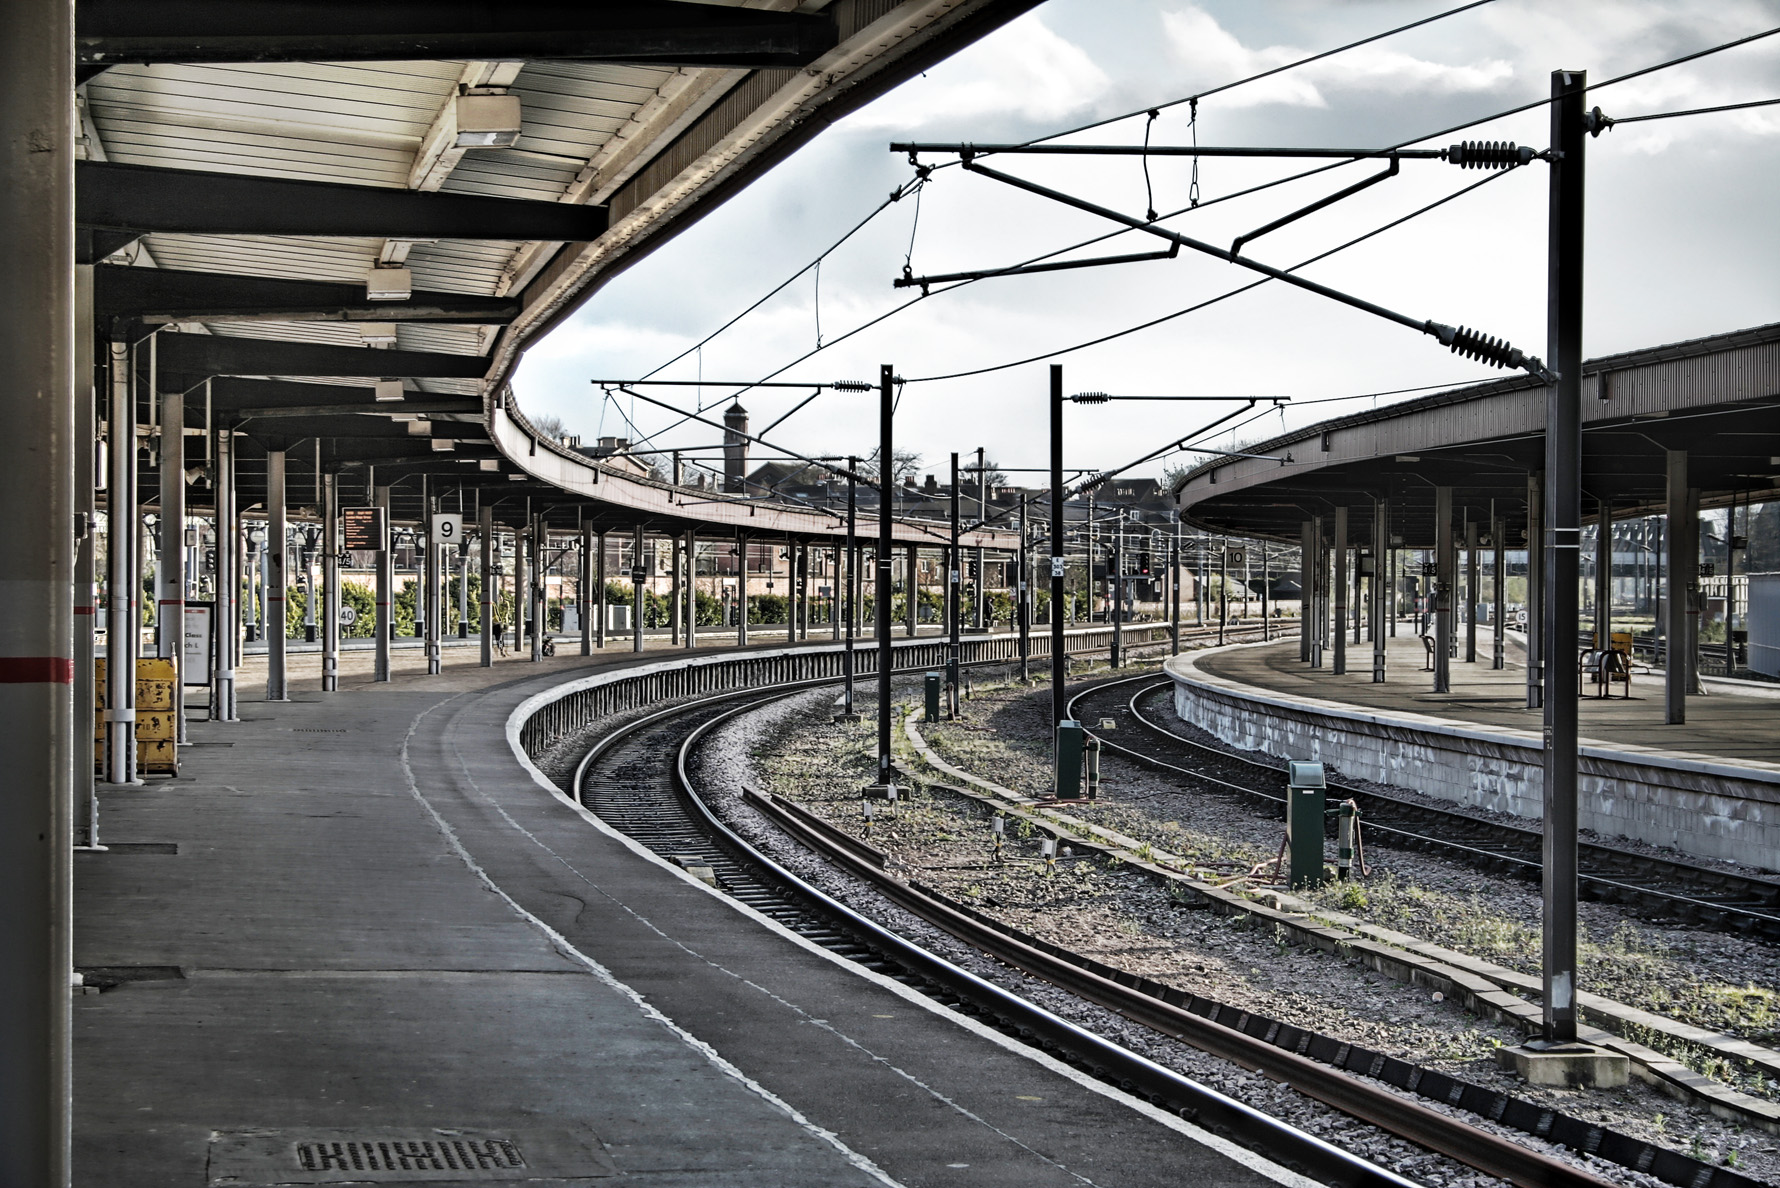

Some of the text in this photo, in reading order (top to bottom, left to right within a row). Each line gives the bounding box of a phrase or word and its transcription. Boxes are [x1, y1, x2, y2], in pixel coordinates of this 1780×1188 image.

[441, 521, 453, 537] 9
[1229, 552, 1243, 563] 10
[340, 610, 354, 620] 40
[1518, 613, 1526, 621] 15
